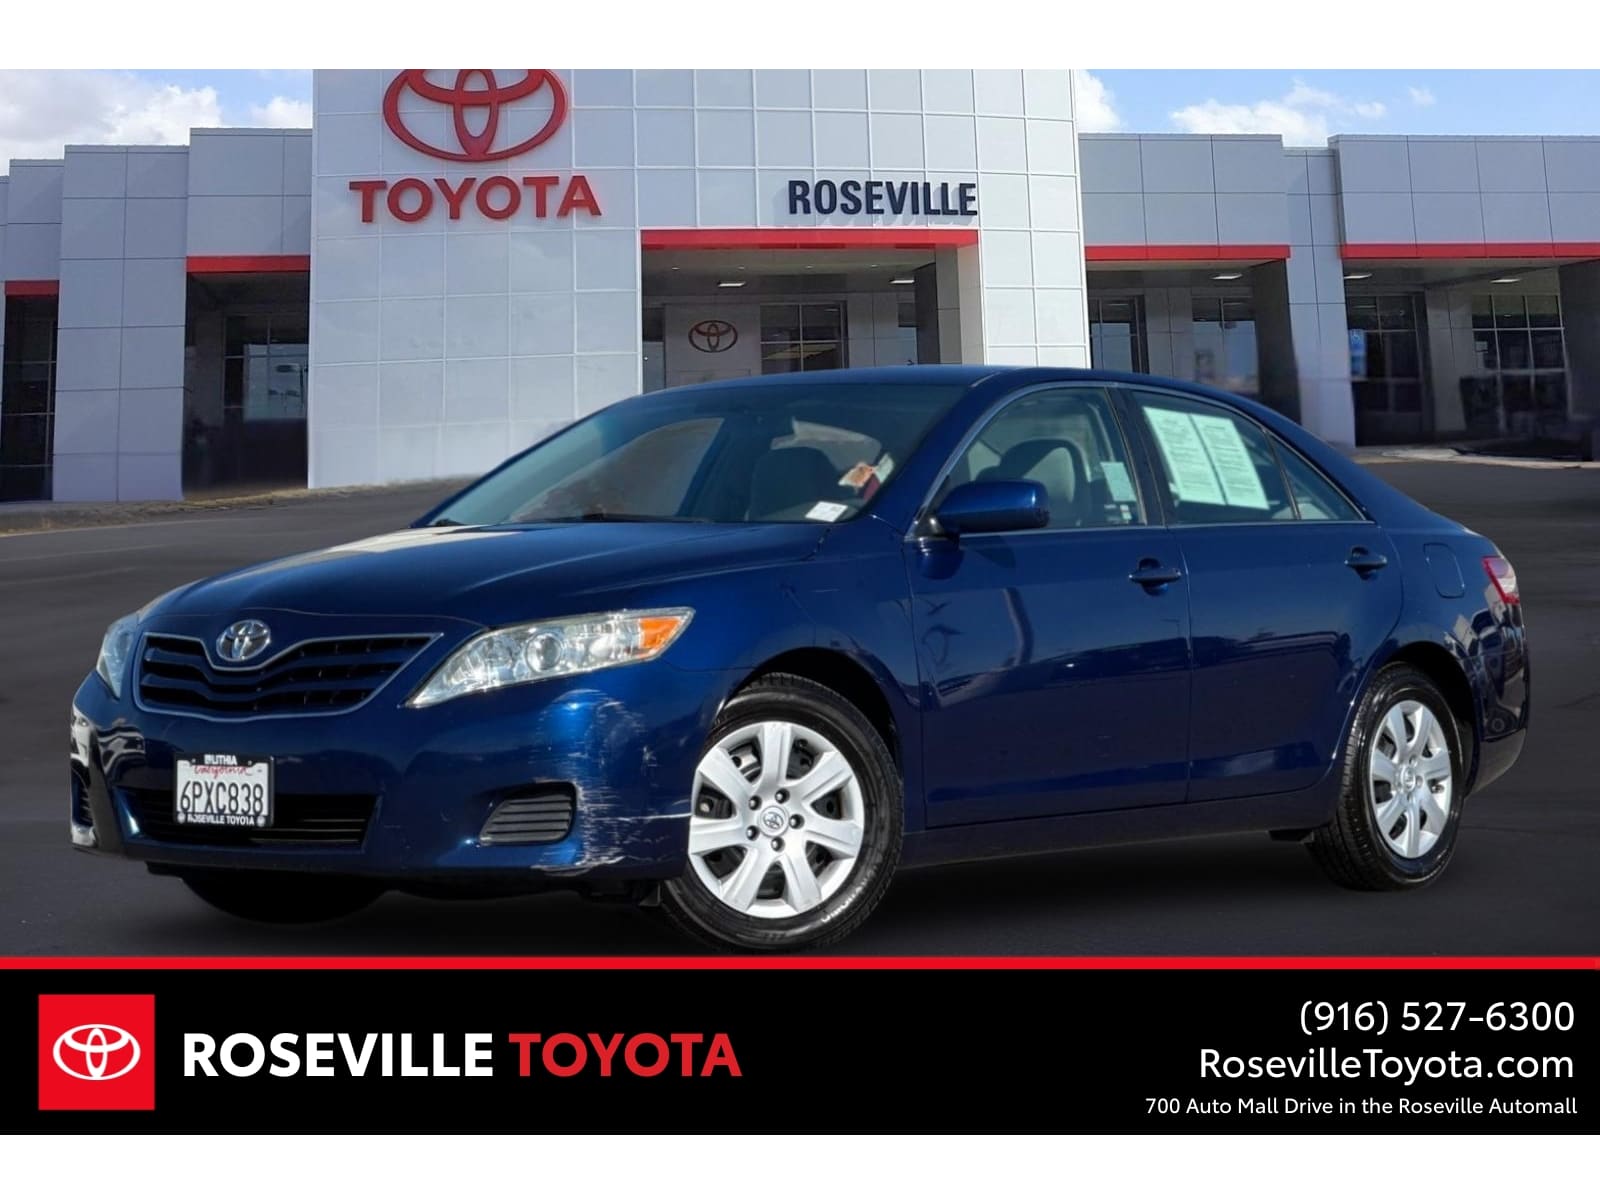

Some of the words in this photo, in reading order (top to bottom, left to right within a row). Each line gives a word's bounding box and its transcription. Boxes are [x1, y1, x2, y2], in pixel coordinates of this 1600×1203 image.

[349, 175, 602, 222] TOYOTA
[788, 180, 978, 216] ROSEVILLE
[180, 780, 264, 815] 6PXC838
[226, 815, 255, 826] TOYOTA
